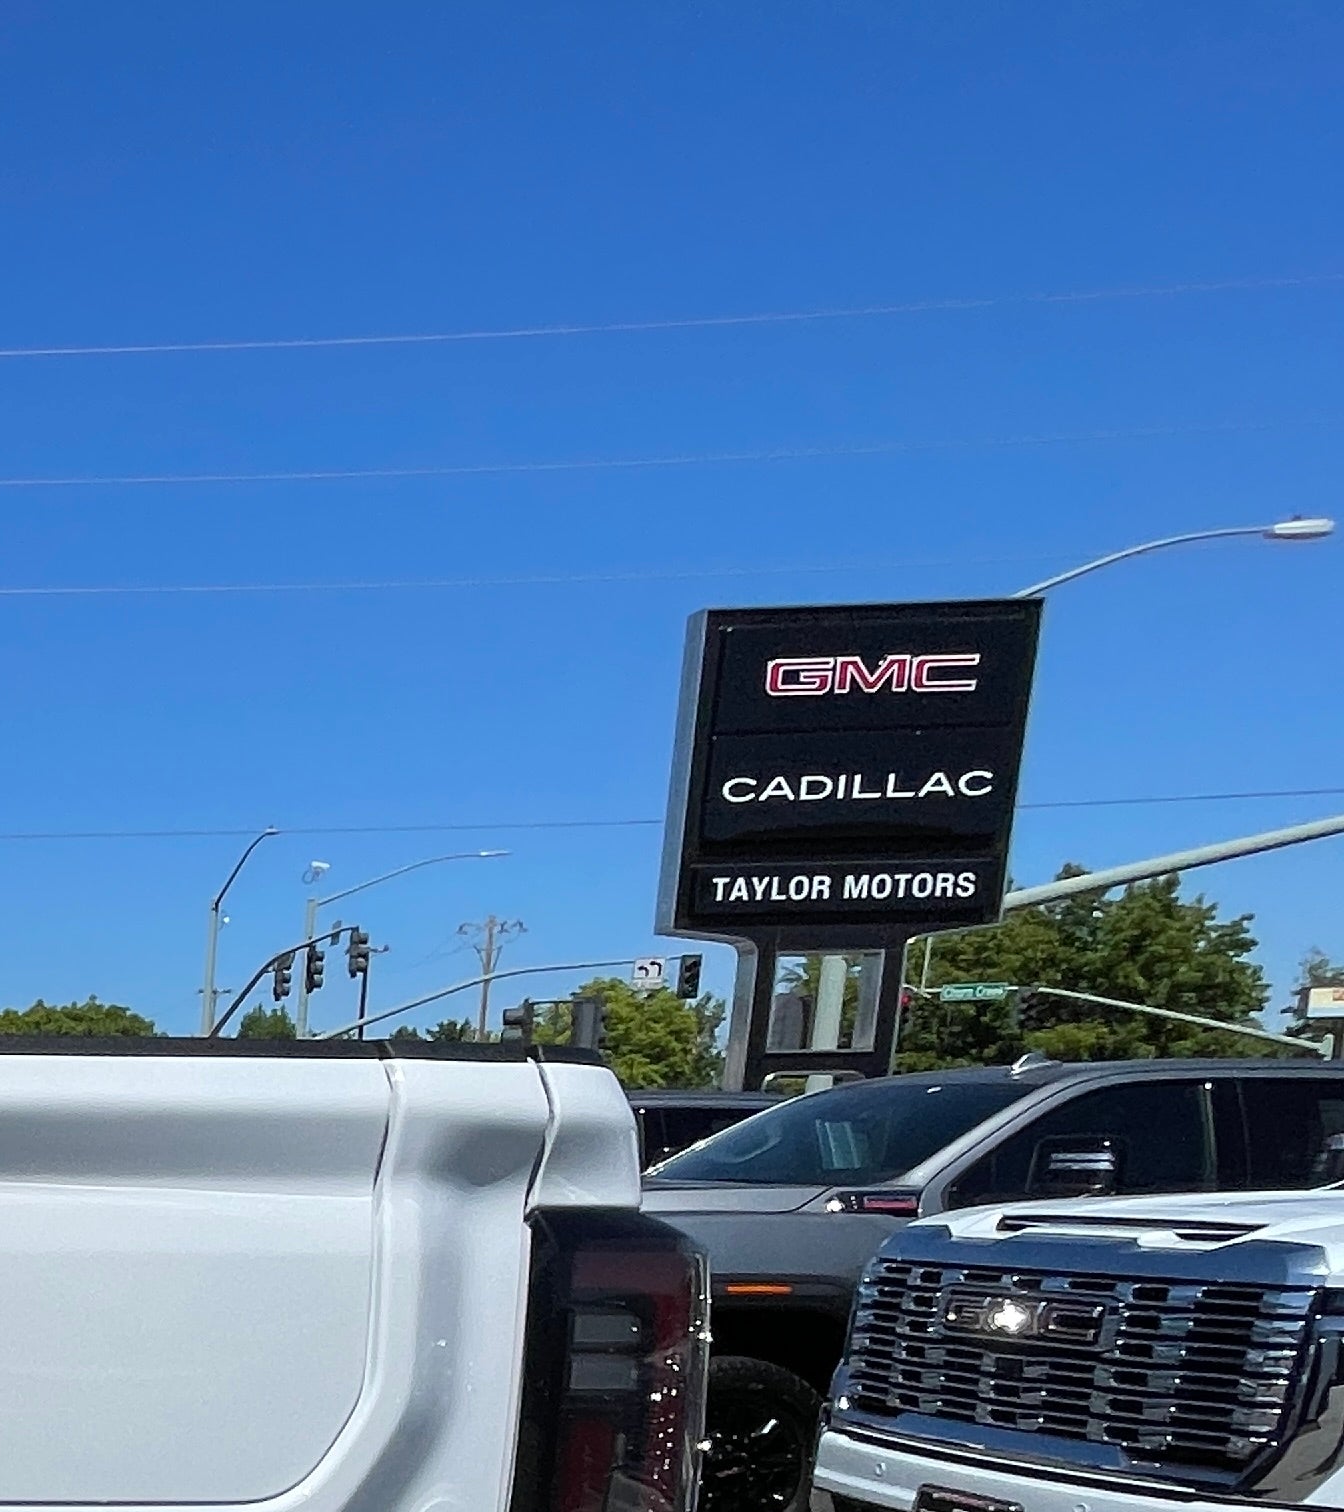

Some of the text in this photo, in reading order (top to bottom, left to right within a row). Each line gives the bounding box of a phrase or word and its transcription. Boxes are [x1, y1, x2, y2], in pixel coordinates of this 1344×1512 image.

[766, 653, 980, 695] GMC
[722, 770, 994, 803] CADILLAC
[712, 872, 977, 901] TAYLOR MOTORS
